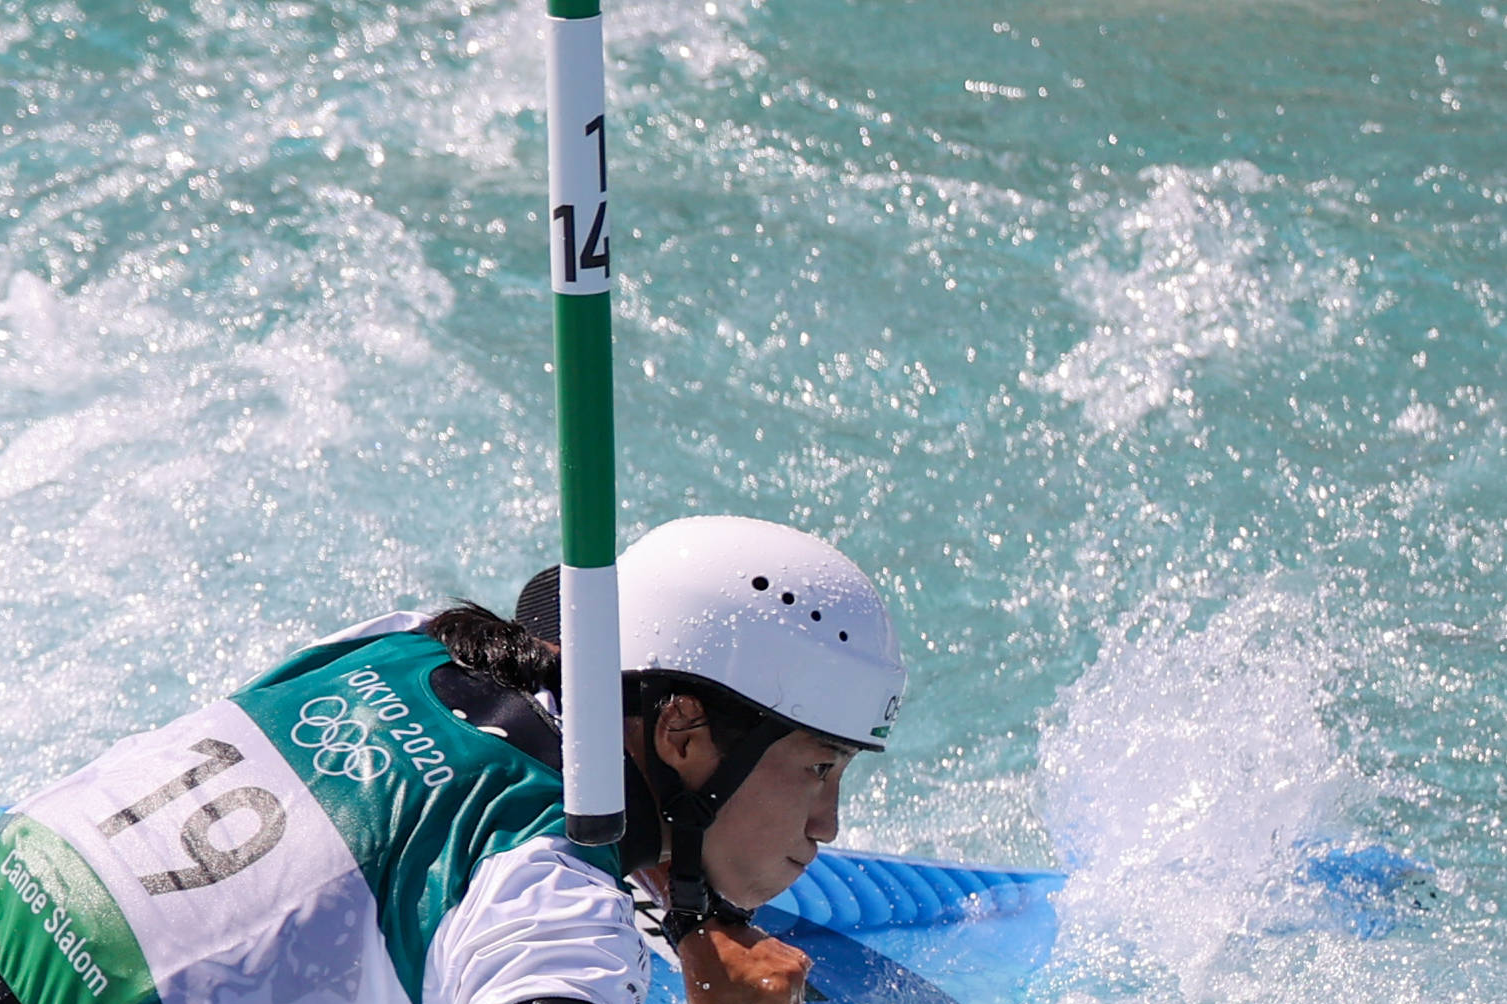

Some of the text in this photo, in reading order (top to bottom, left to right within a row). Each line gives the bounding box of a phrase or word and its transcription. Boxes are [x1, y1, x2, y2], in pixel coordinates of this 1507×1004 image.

[553, 200, 610, 283] 14
[342, 665, 454, 787] OKYO 2020
[96, 737, 287, 896] 19
[0, 849, 108, 997] Canoe Slalom
